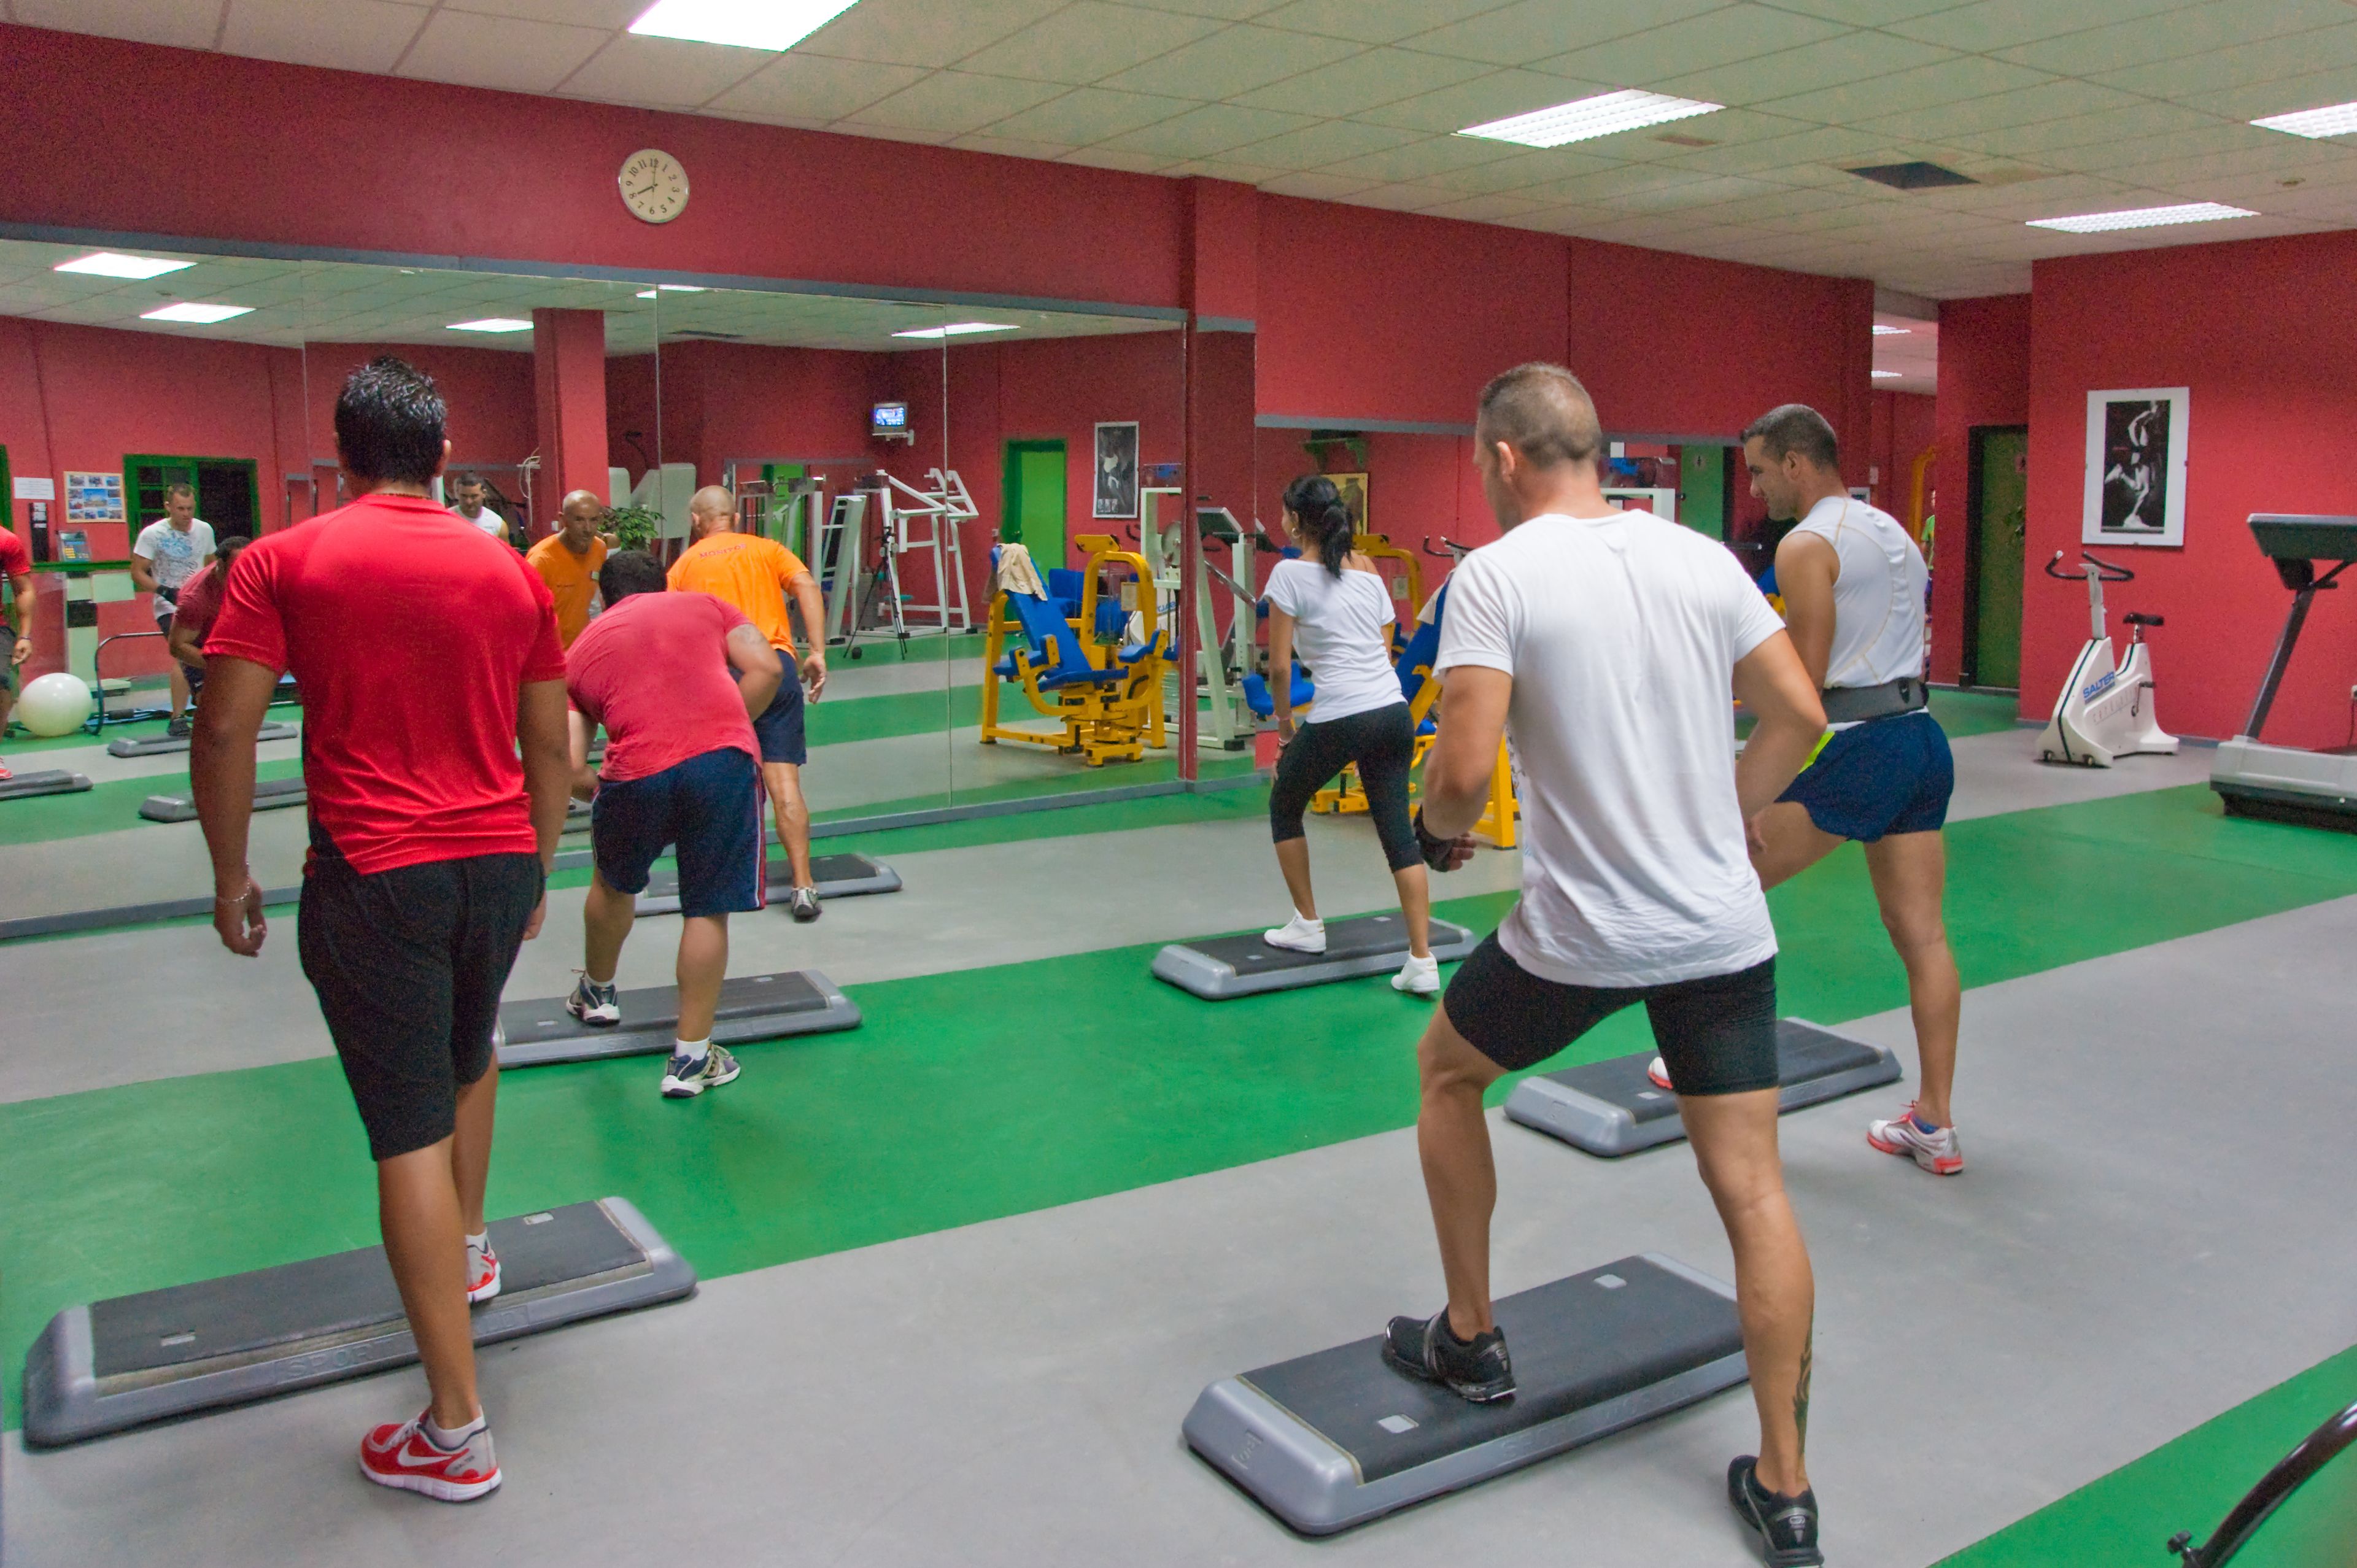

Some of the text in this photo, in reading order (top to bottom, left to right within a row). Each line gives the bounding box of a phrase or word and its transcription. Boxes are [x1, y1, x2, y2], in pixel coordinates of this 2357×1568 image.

[630, 168, 639, 177] 10
[700, 544, 746, 557] MONITOR
[2083, 671, 2115, 698] SALTER
